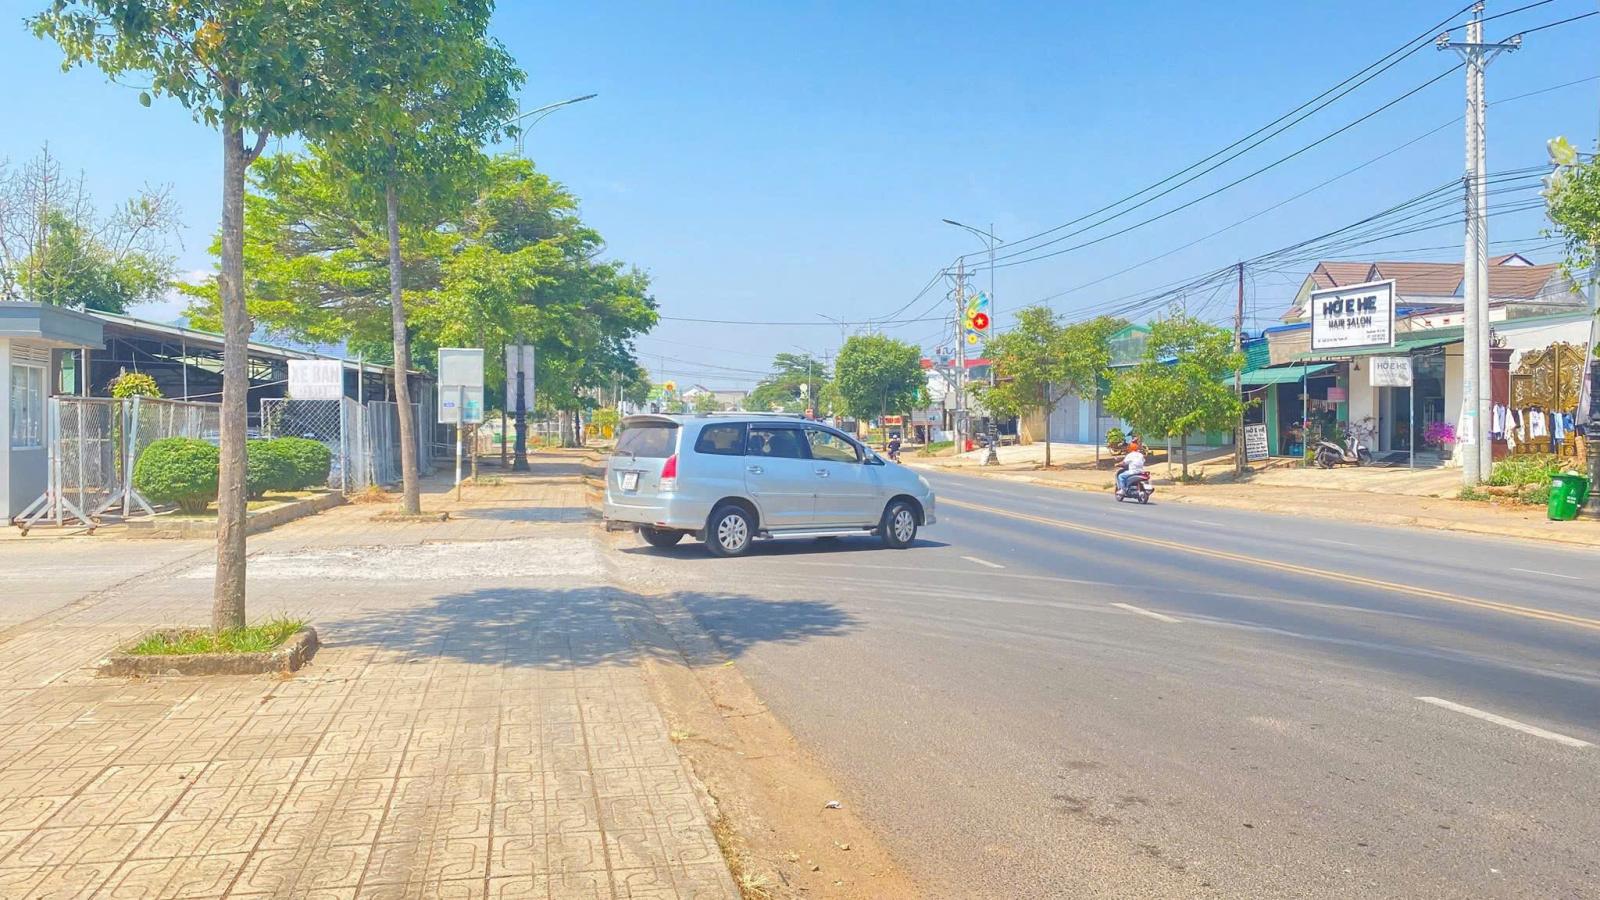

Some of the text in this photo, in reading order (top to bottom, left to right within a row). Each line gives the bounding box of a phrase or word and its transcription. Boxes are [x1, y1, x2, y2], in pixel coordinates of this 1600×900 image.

[1346, 299, 1355, 313] E
[1357, 295, 1377, 311] HE
[1328, 316, 1372, 329] HAIR SALON
